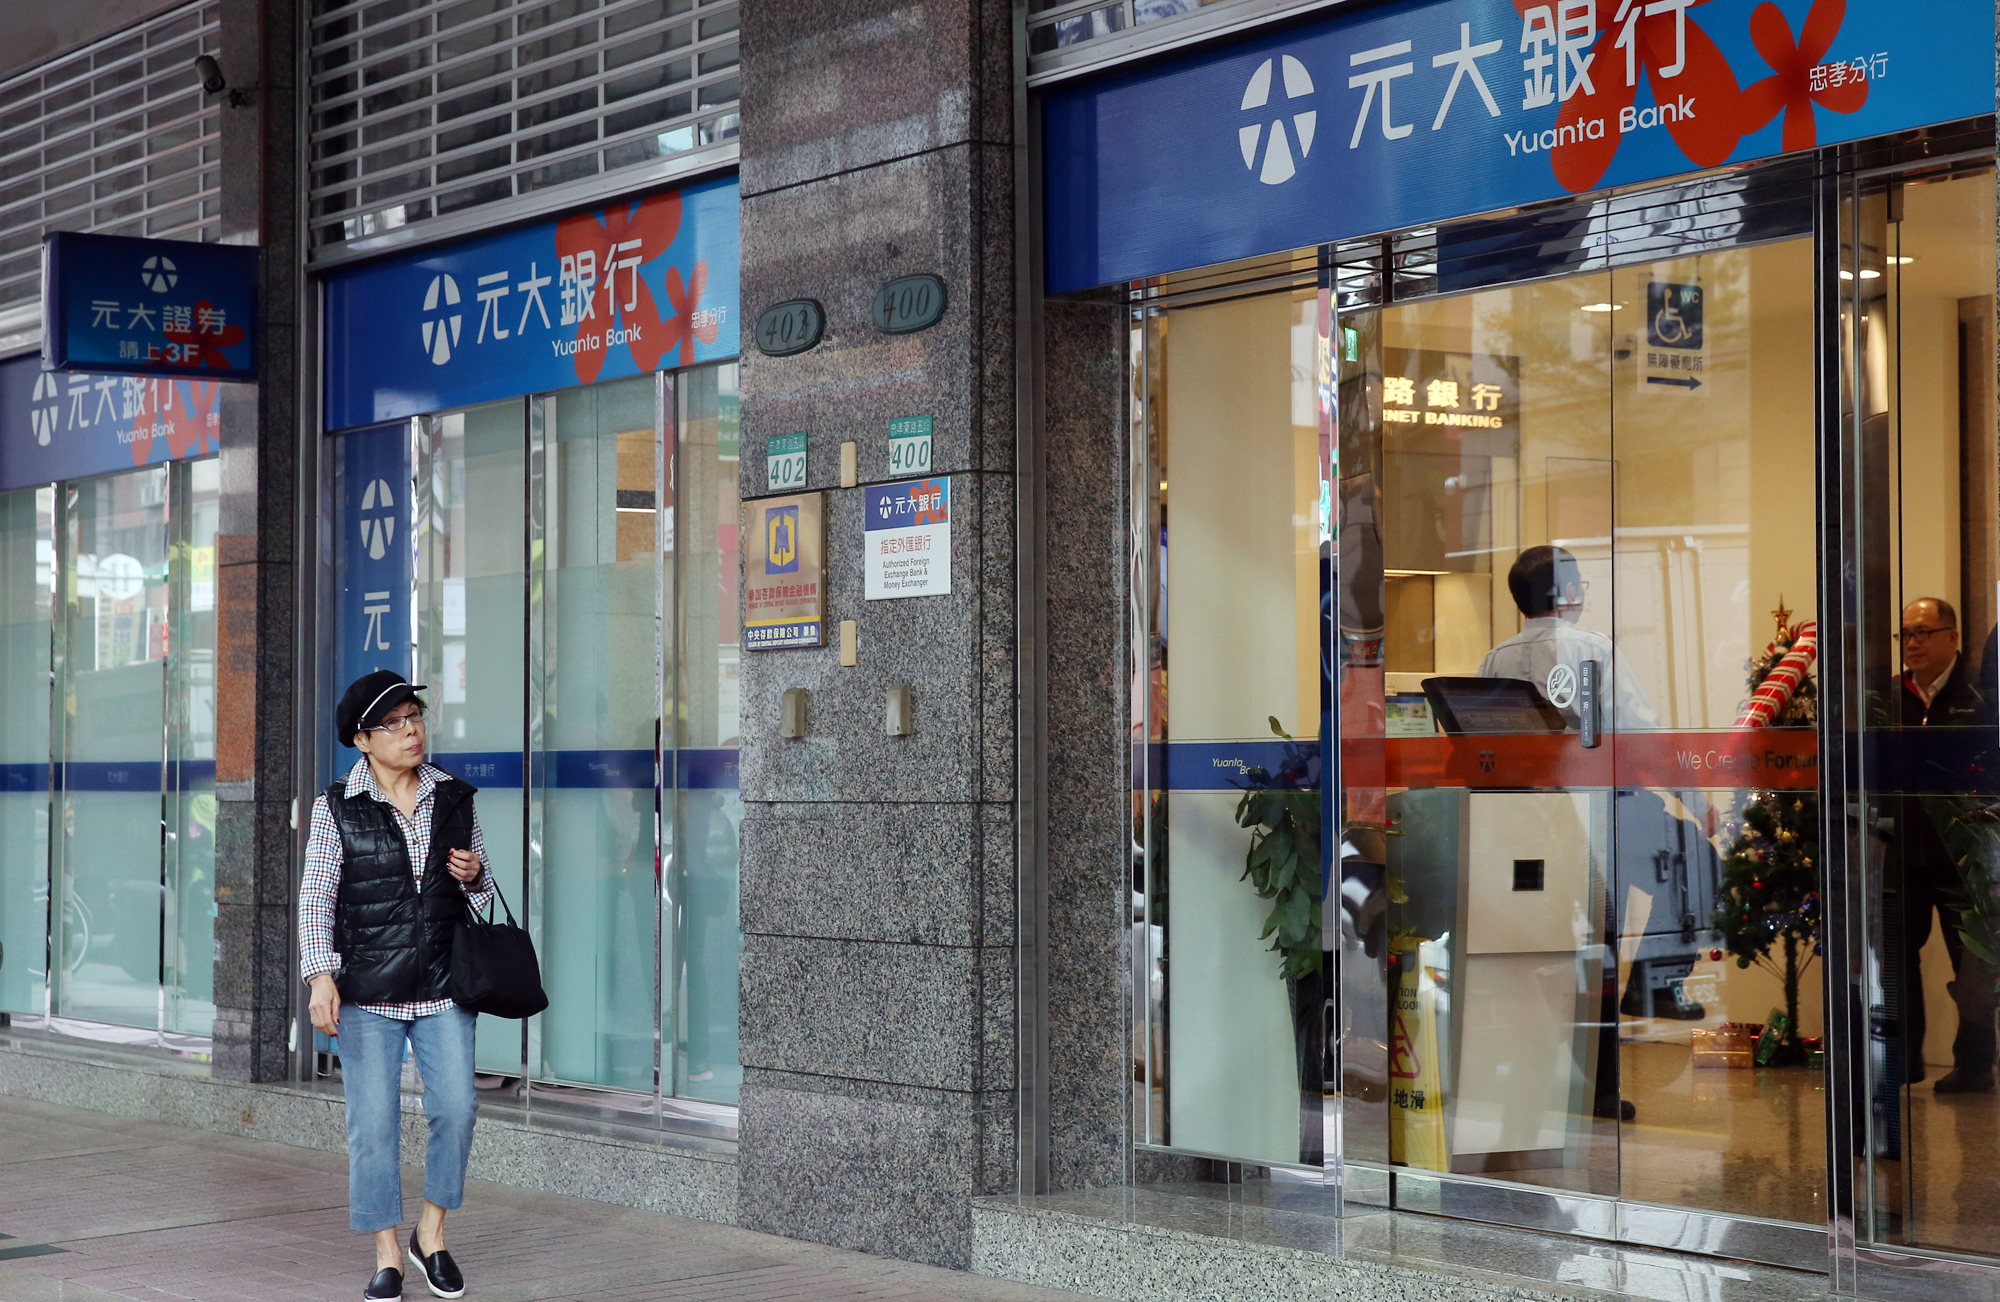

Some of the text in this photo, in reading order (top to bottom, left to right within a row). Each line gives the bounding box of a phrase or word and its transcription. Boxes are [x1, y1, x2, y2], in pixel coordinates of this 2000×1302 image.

[1348, 0, 1693, 150] 元大銀行
[1809, 52, 1888, 92] 忠孝分行
[1503, 96, 1696, 157] Yuanta Bank
[477, 238, 644, 344] 元大銀行
[1680, 290, 1700, 304] WC
[882, 284, 930, 323] 400
[91, 300, 227, 335] 元大證券
[691, 306, 727, 328] 忠孝分行
[765, 309, 809, 346] 402
[551, 323, 642, 358] Yuanta Bank
[68, 374, 173, 431] 元大銀行
[1425, 412, 1503, 429] BANKING
[117, 420, 175, 445] Yuanta Bank
[891, 440, 929, 470] 400
[770, 456, 805, 485] 402
[895, 492, 942, 515] 元大銀行
[880, 534, 932, 555] 指定外匯銀行
[883, 557, 930, 569] Authorized Foreign
[884, 569, 909, 579] Exchange
[909, 567, 923, 577] Bank
[883, 578, 929, 590] Money Exchanger
[464, 763, 495, 777] 元大銀行
[1212, 757, 1244, 768] Yuanta
[1239, 765, 1263, 775] Bank
[1676, 750, 1701, 769] We
[1394, 1088, 1425, 1110] 地滑
